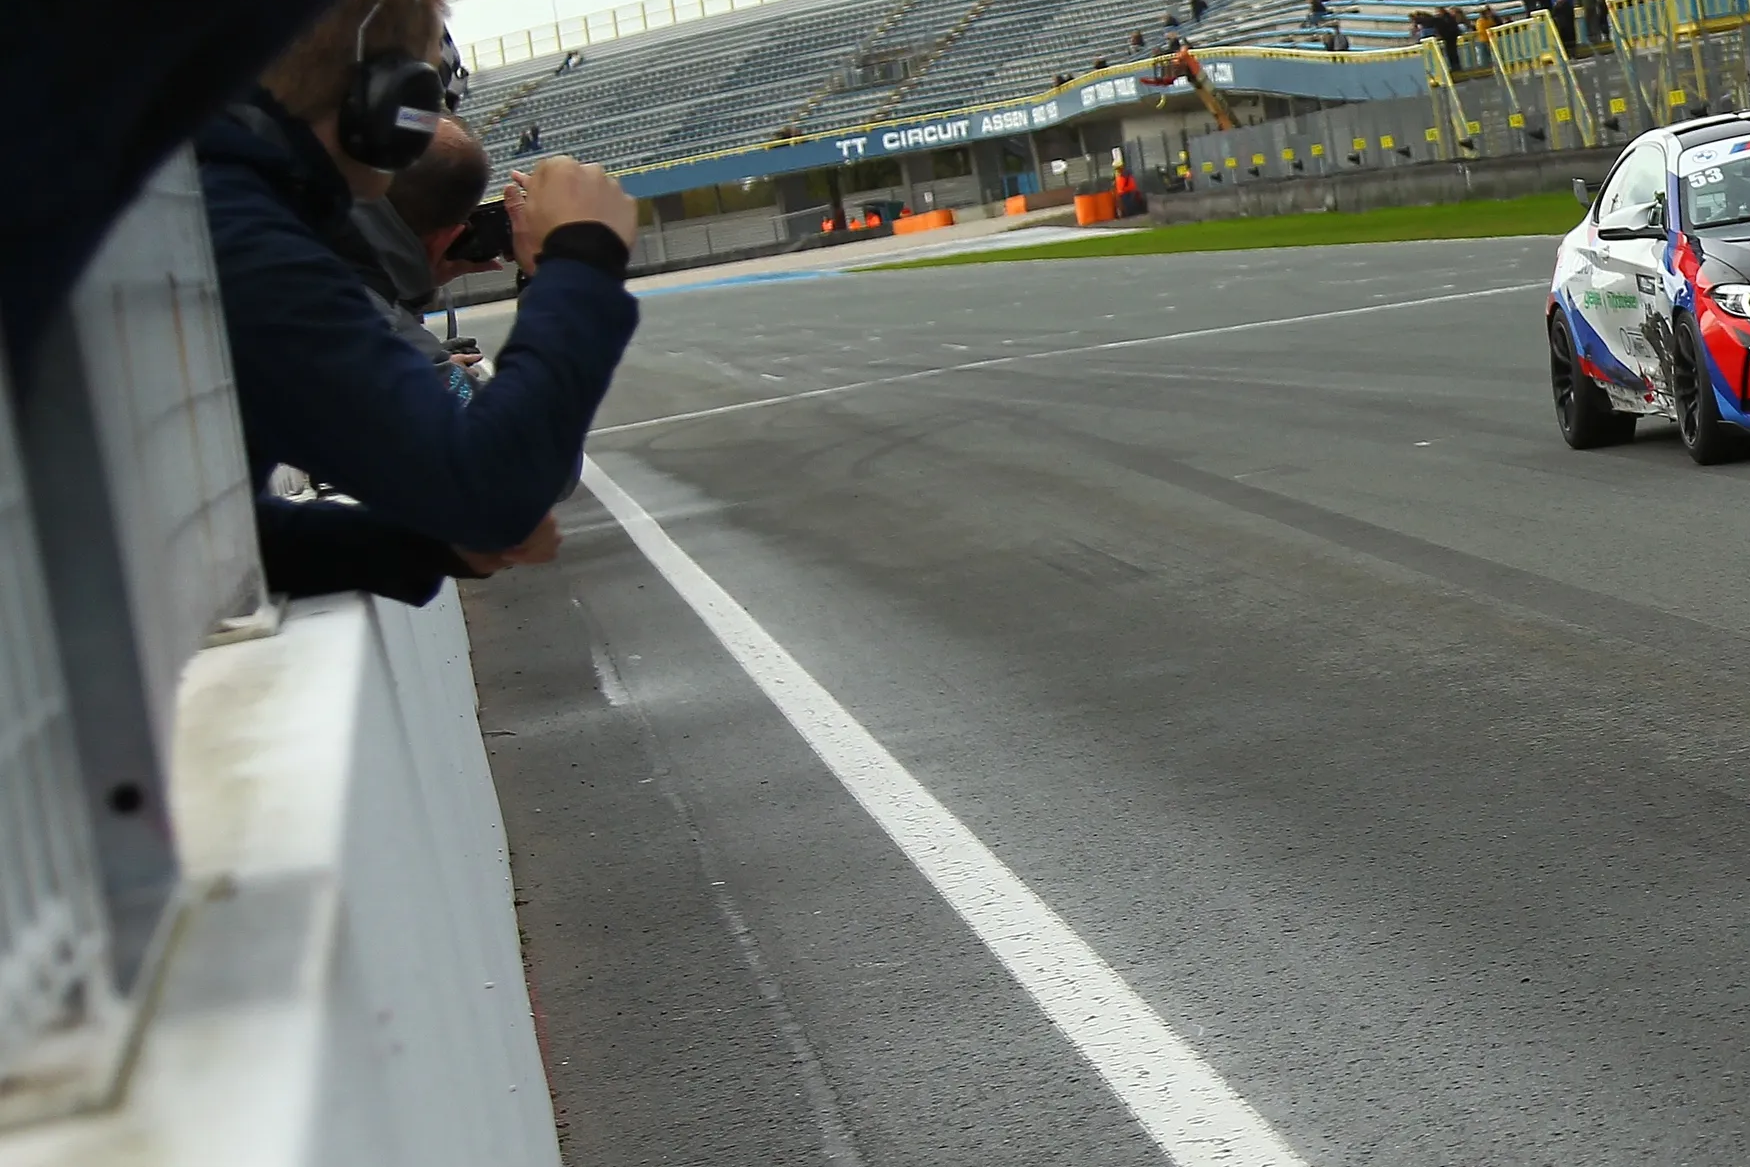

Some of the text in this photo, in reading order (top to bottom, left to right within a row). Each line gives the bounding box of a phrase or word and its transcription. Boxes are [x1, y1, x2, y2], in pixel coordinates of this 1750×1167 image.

[836, 136, 868, 157] TT
[882, 120, 970, 151] CIRCUIT
[1688, 167, 1725, 189] 53
